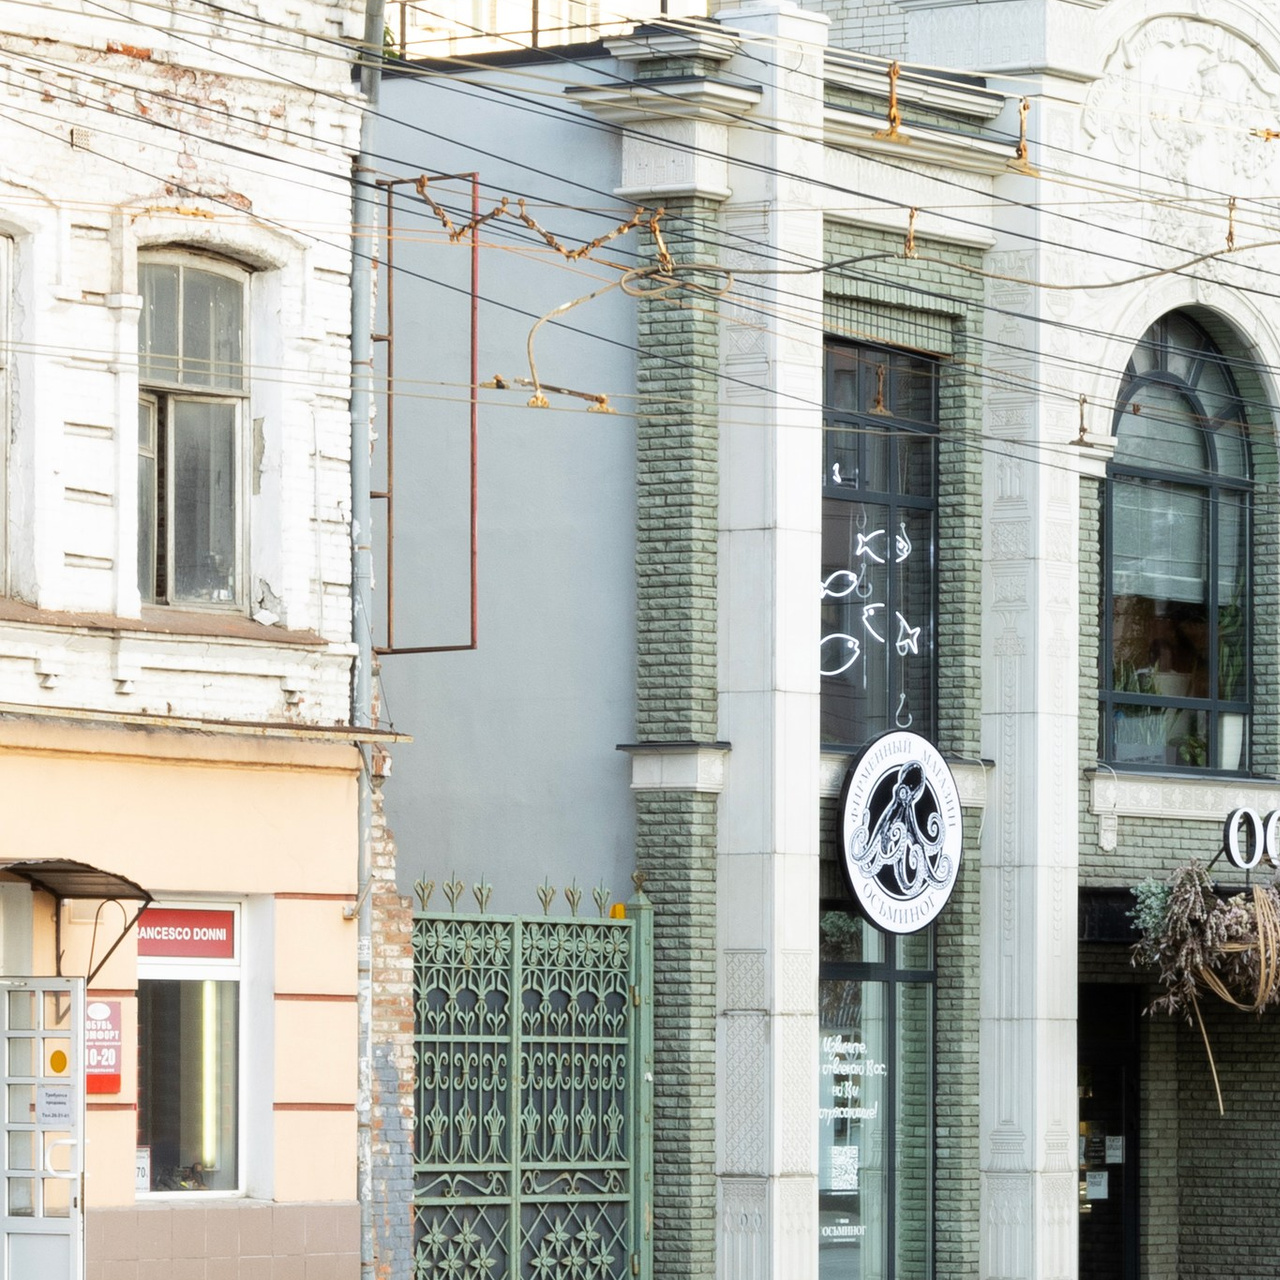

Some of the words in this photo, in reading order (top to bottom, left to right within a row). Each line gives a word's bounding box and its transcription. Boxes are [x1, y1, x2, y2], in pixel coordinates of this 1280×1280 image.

[852, 738, 912, 823] ФИРМЕННЫЙ
[920, 750, 957, 827] МАГАЗИН
[862, 882, 936, 925] ОСЬМИНОГ
[193, 927, 227, 941] DONNI
[86, 1048, 116, 1066] 10-20
[822, 1225, 867, 1236] ОСЬМИНОГ
